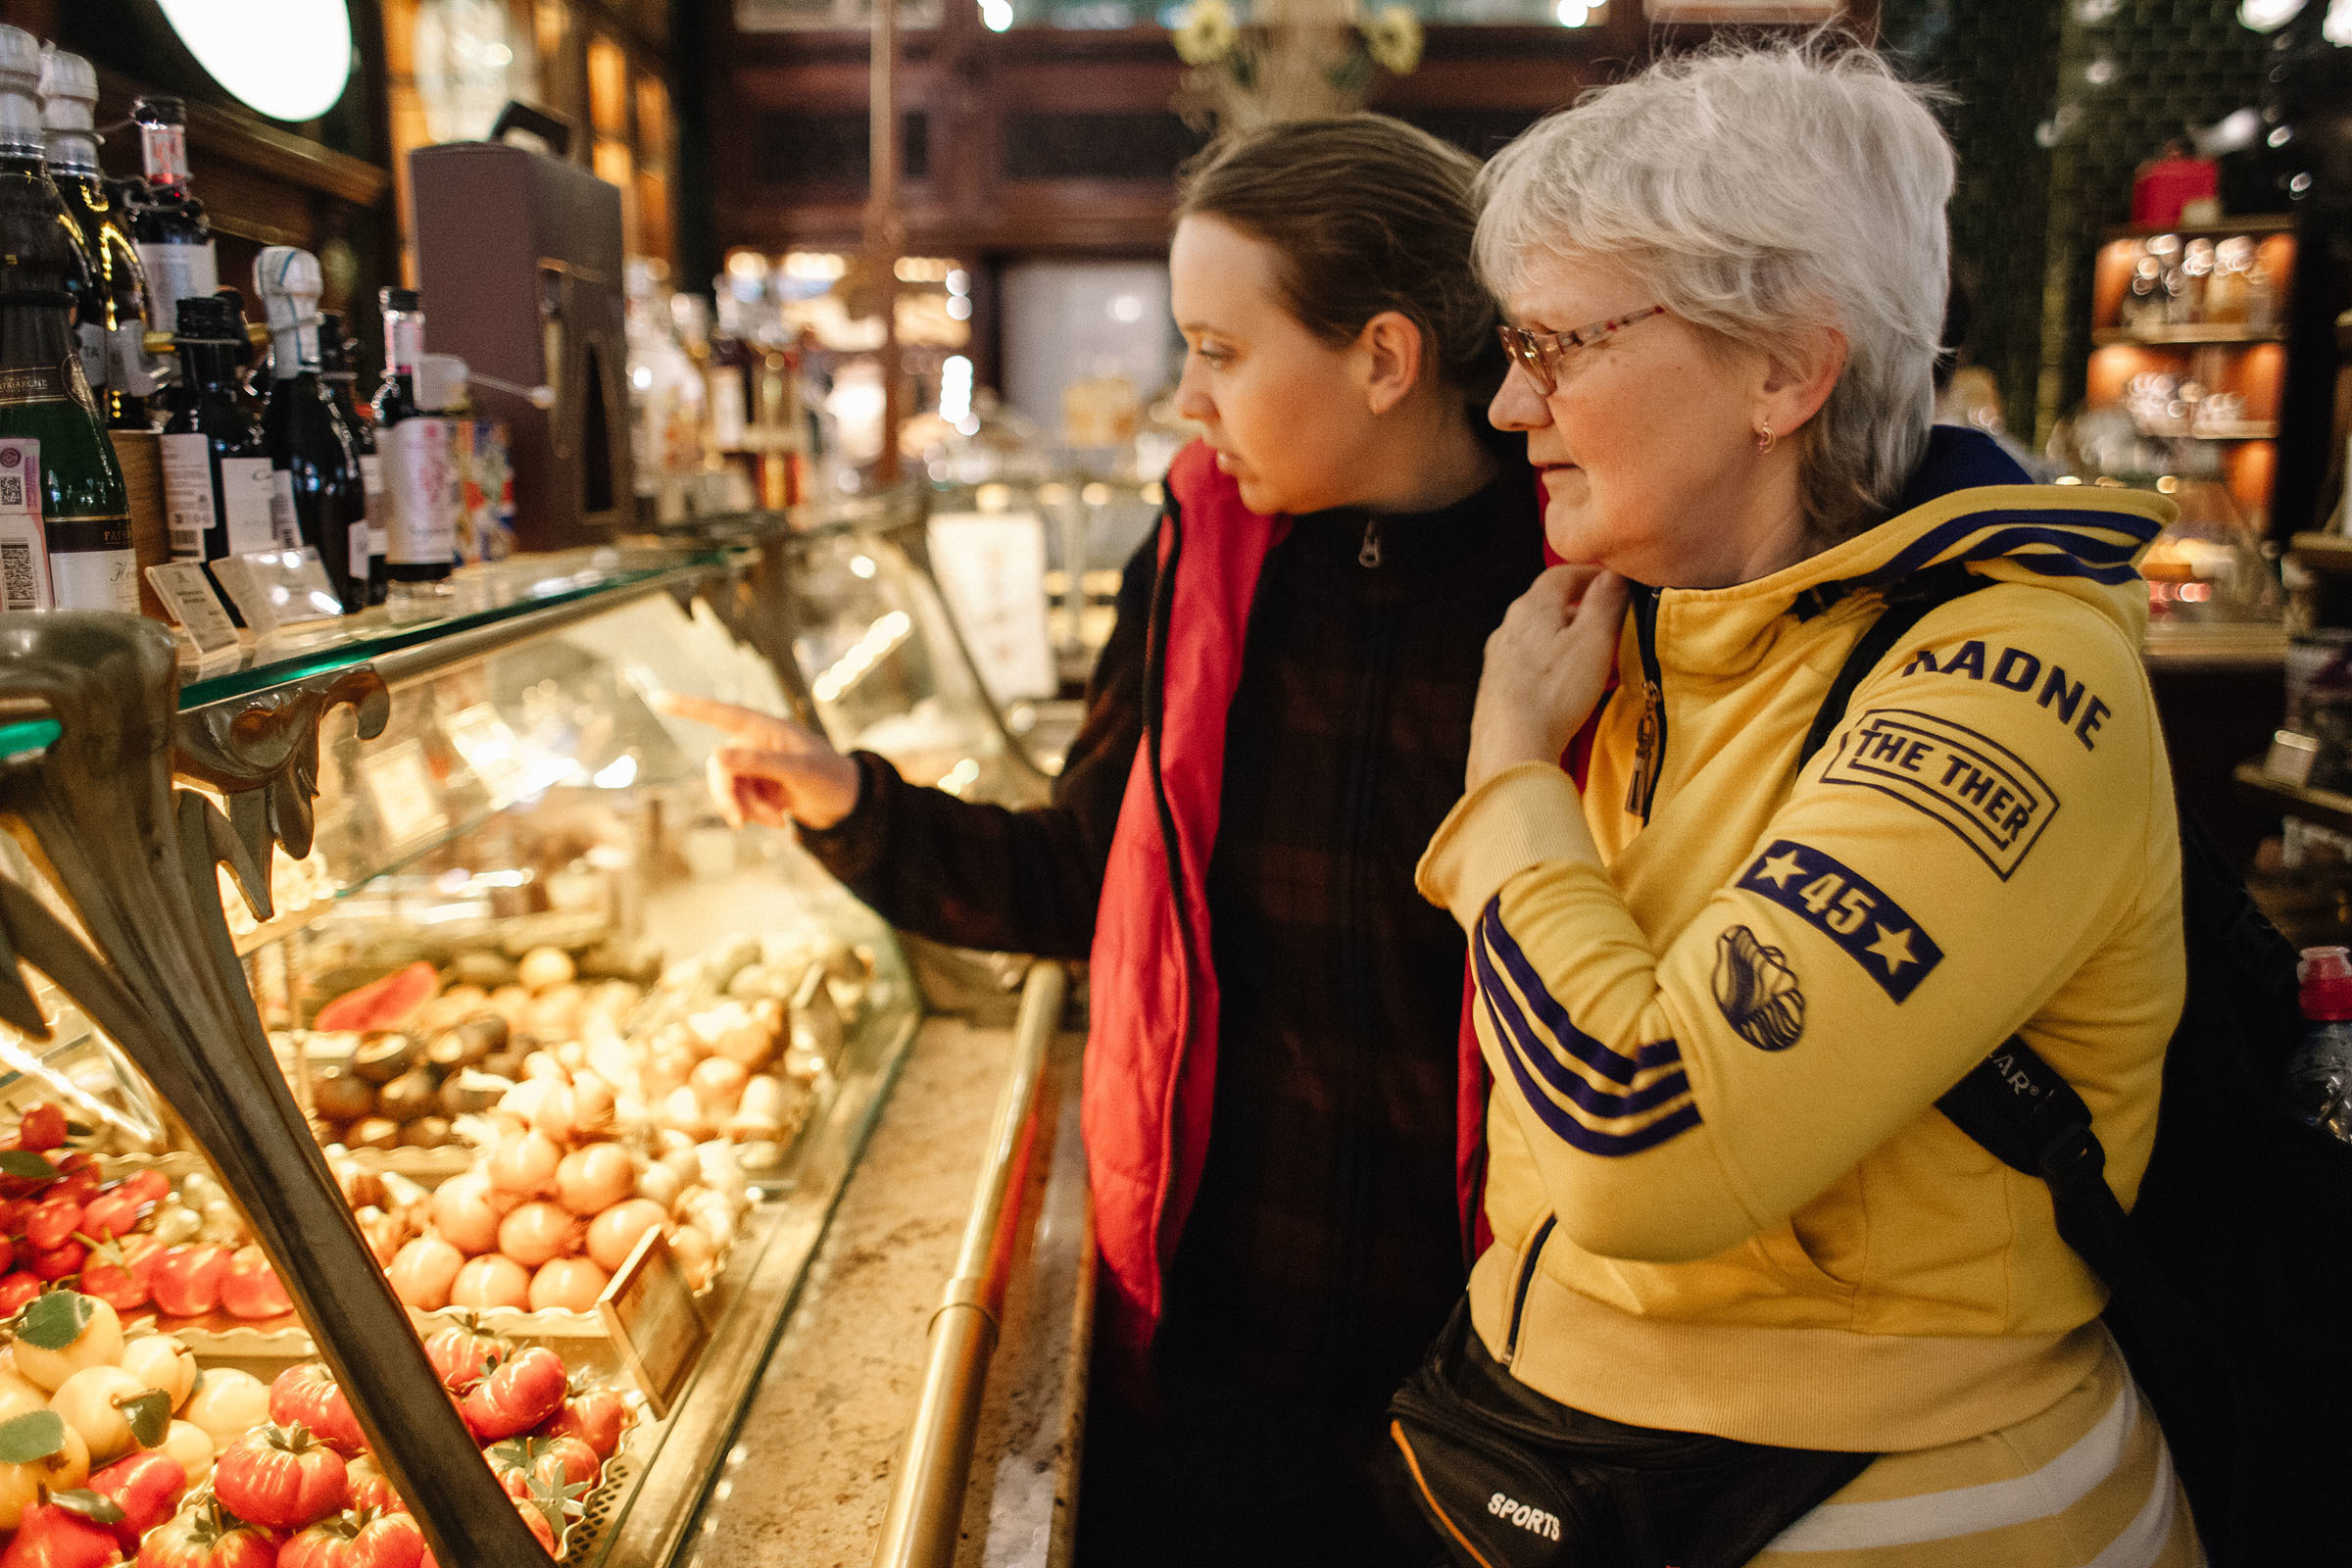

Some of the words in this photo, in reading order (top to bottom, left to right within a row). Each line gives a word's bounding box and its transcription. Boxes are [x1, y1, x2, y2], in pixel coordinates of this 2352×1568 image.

[1859, 729, 1935, 772] THE
[1939, 754, 2031, 843] THER
[1798, 872, 1878, 935] 45
[1987, 1052, 2031, 1096] AR
[1487, 1492, 1561, 1542] SPORTS
